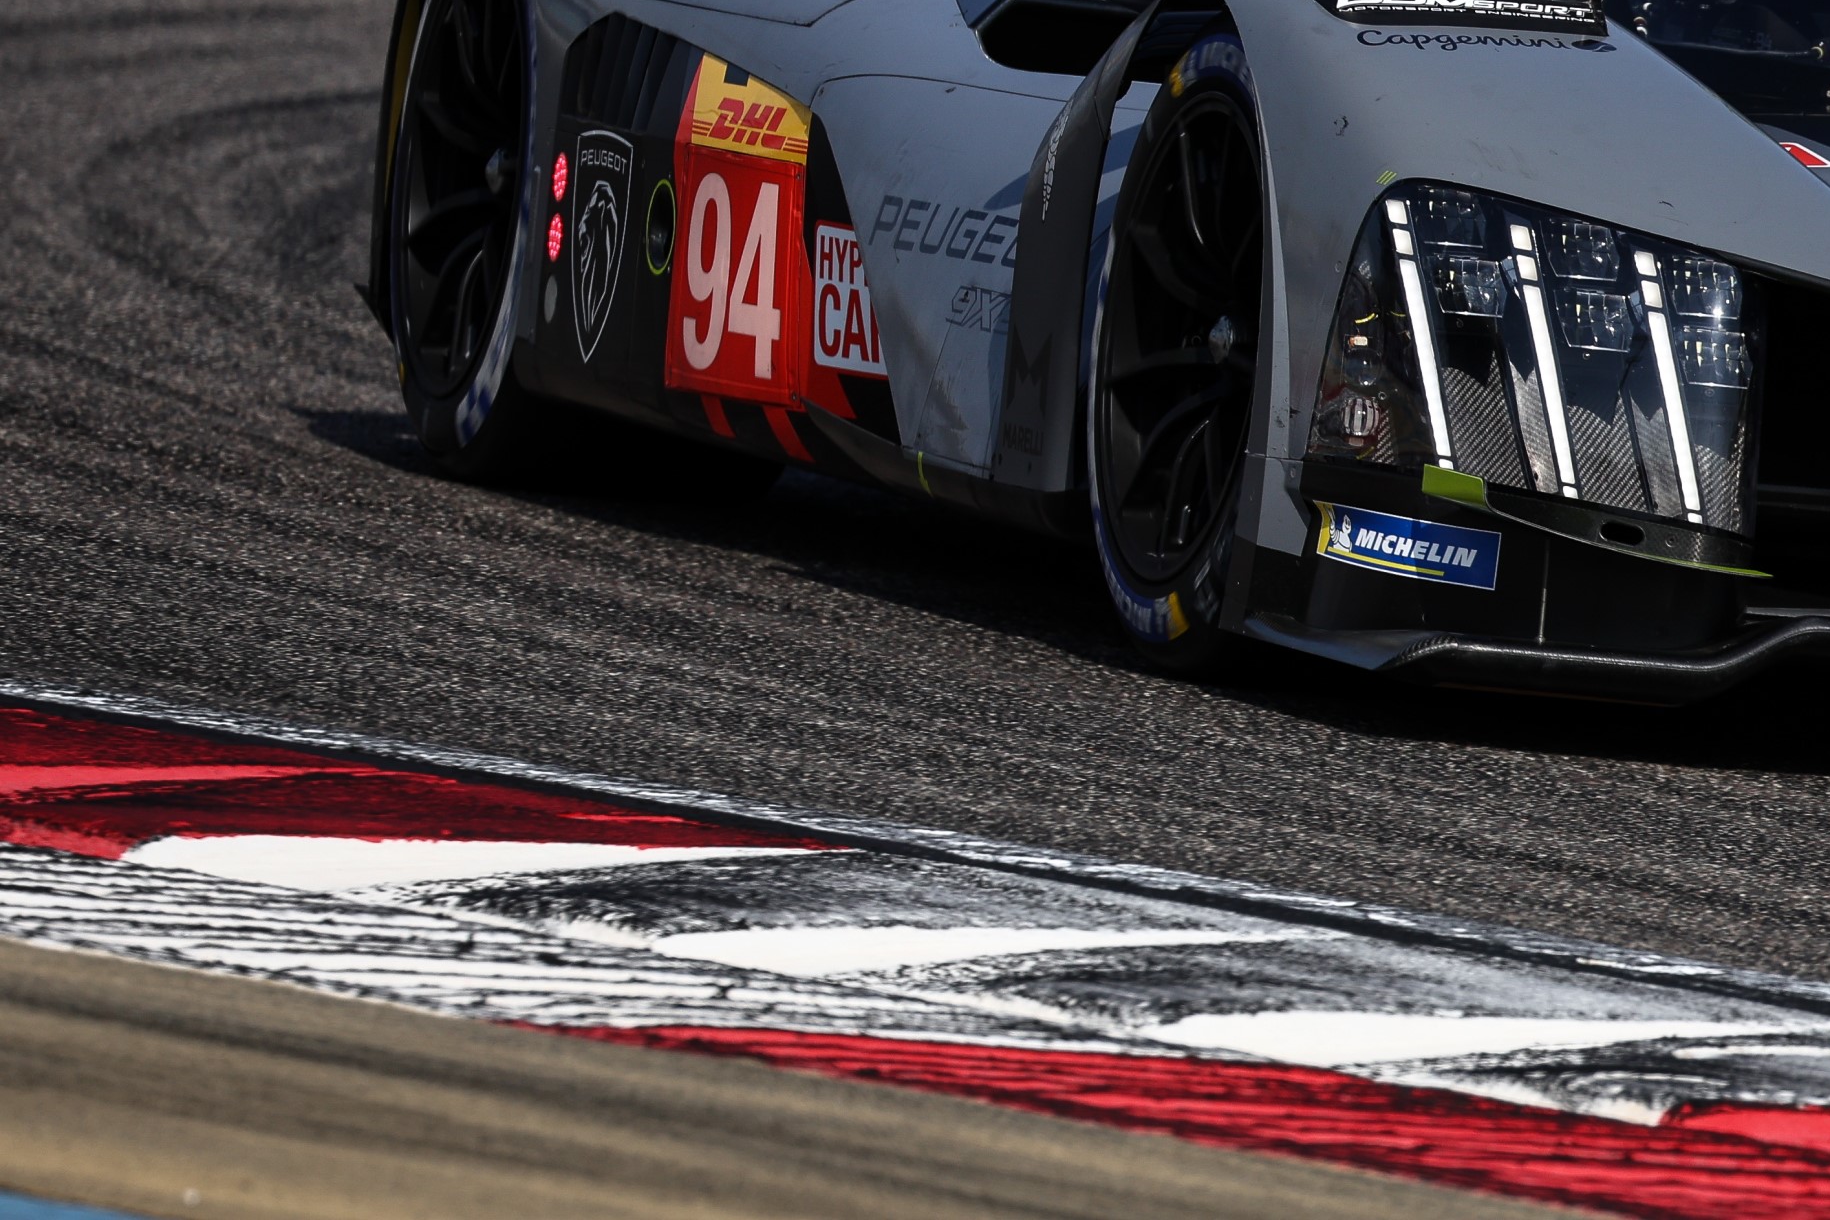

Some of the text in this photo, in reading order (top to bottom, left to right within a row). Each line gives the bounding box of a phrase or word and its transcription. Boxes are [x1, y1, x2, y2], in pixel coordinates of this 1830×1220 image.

[1356, 29, 1572, 52] Capgemini
[709, 97, 787, 150] DHL
[580, 149, 628, 175] PEUGEOT
[868, 195, 1022, 268] PEUGE
[682, 171, 782, 380] 94
[1354, 528, 1478, 568] MICHELIN
